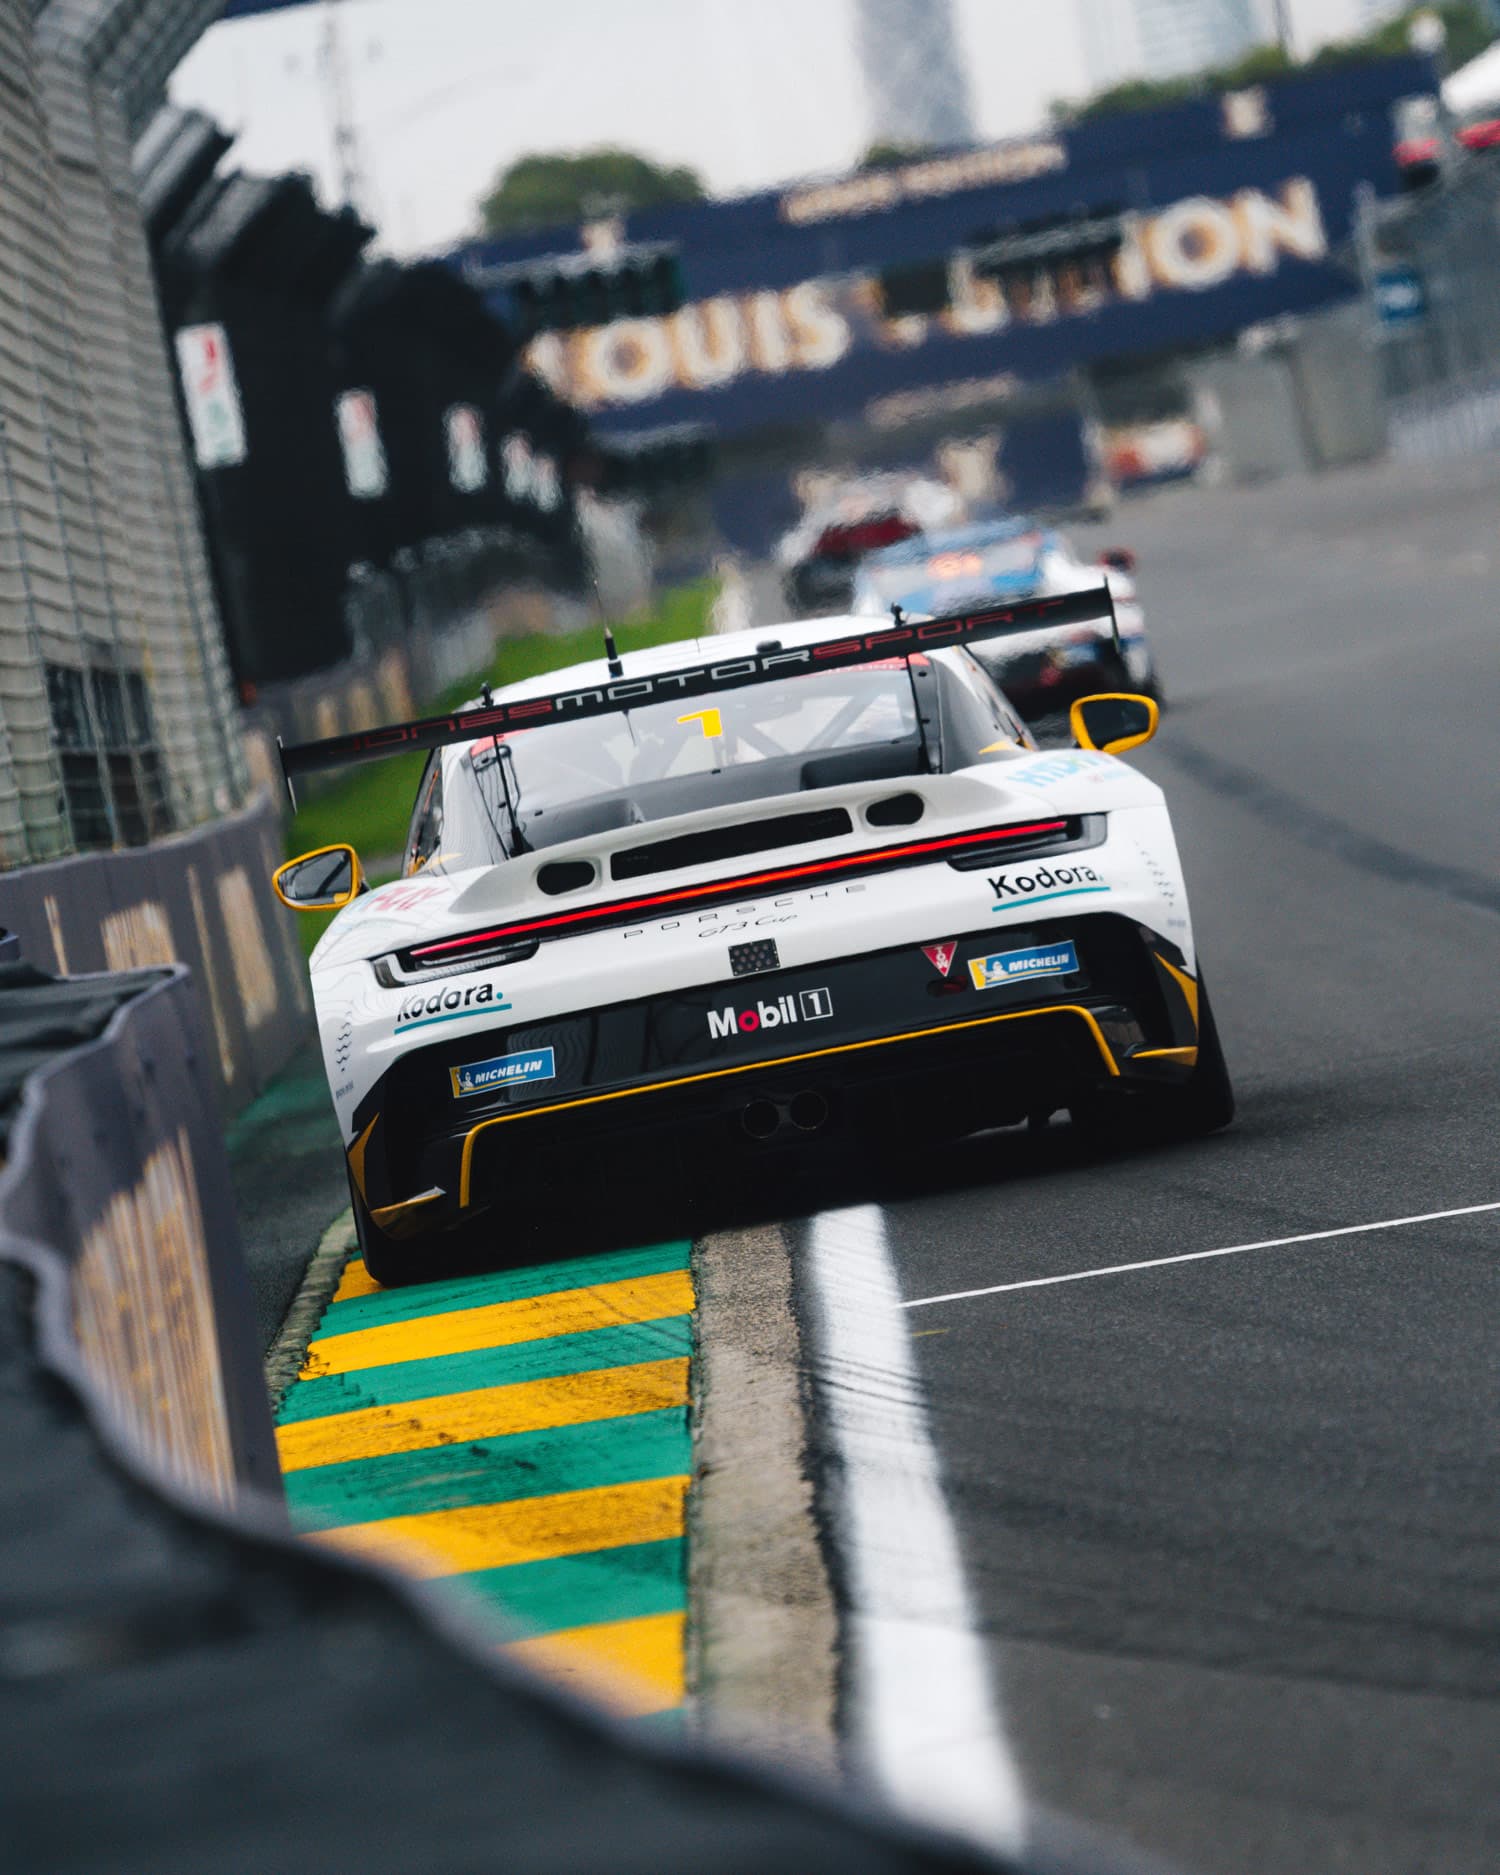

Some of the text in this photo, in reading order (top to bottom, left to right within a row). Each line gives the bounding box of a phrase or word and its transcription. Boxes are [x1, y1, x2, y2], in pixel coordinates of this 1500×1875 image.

[624, 884, 867, 939] PORSCHE
[934, 946, 950, 969] TOW
[1008, 953, 1070, 973] MICHELIN
[707, 994, 798, 1039] Mobil
[474, 1059, 543, 1084] MICHELIN
